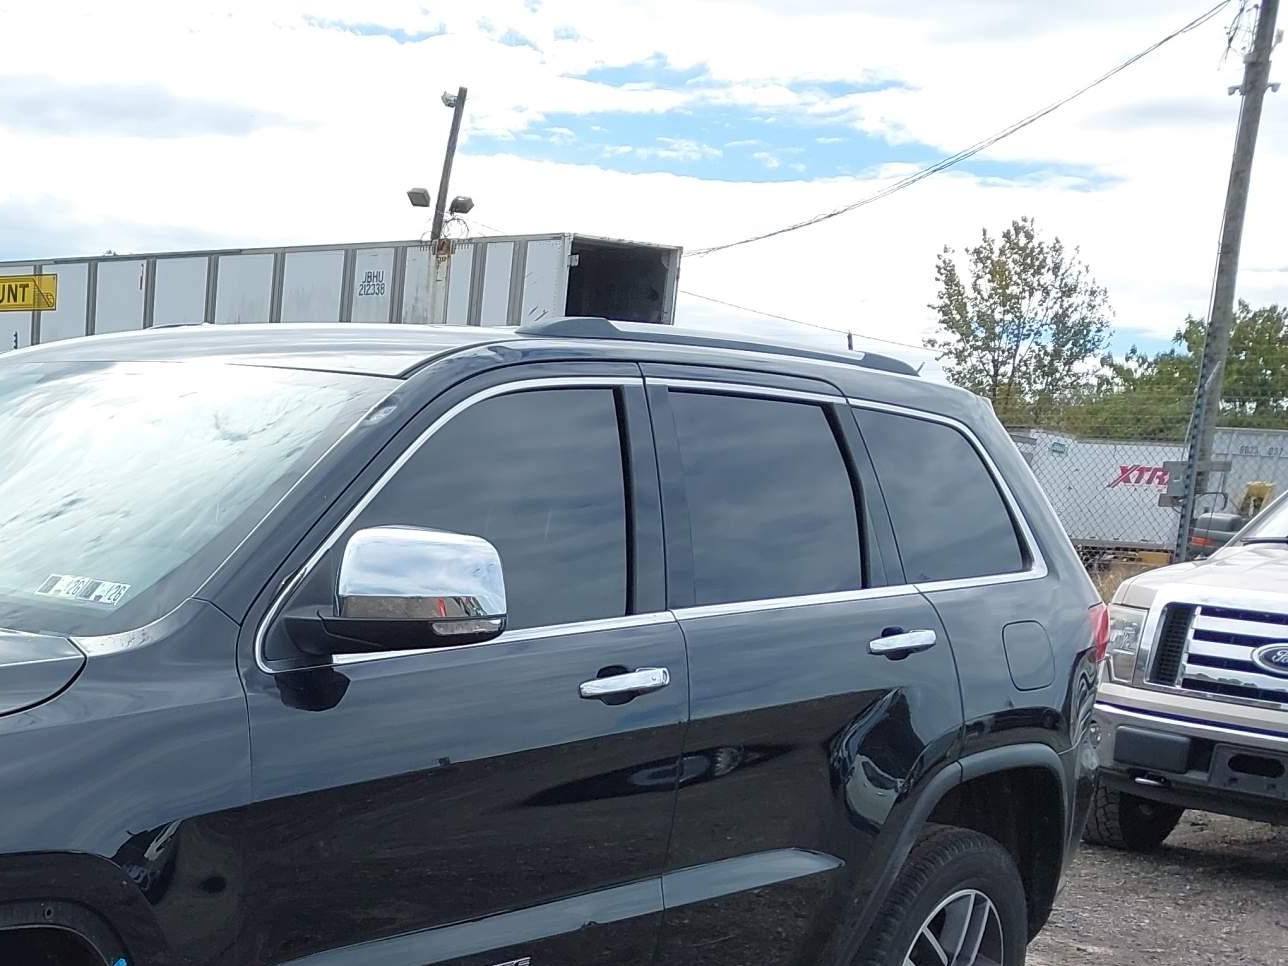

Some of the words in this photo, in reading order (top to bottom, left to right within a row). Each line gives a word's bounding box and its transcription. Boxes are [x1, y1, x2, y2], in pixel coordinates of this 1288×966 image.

[361, 271, 384, 284] JBHU
[358, 283, 385, 296] 212338
[1107, 464, 1169, 488] XTR
[1271, 650, 1288, 664] Fo
